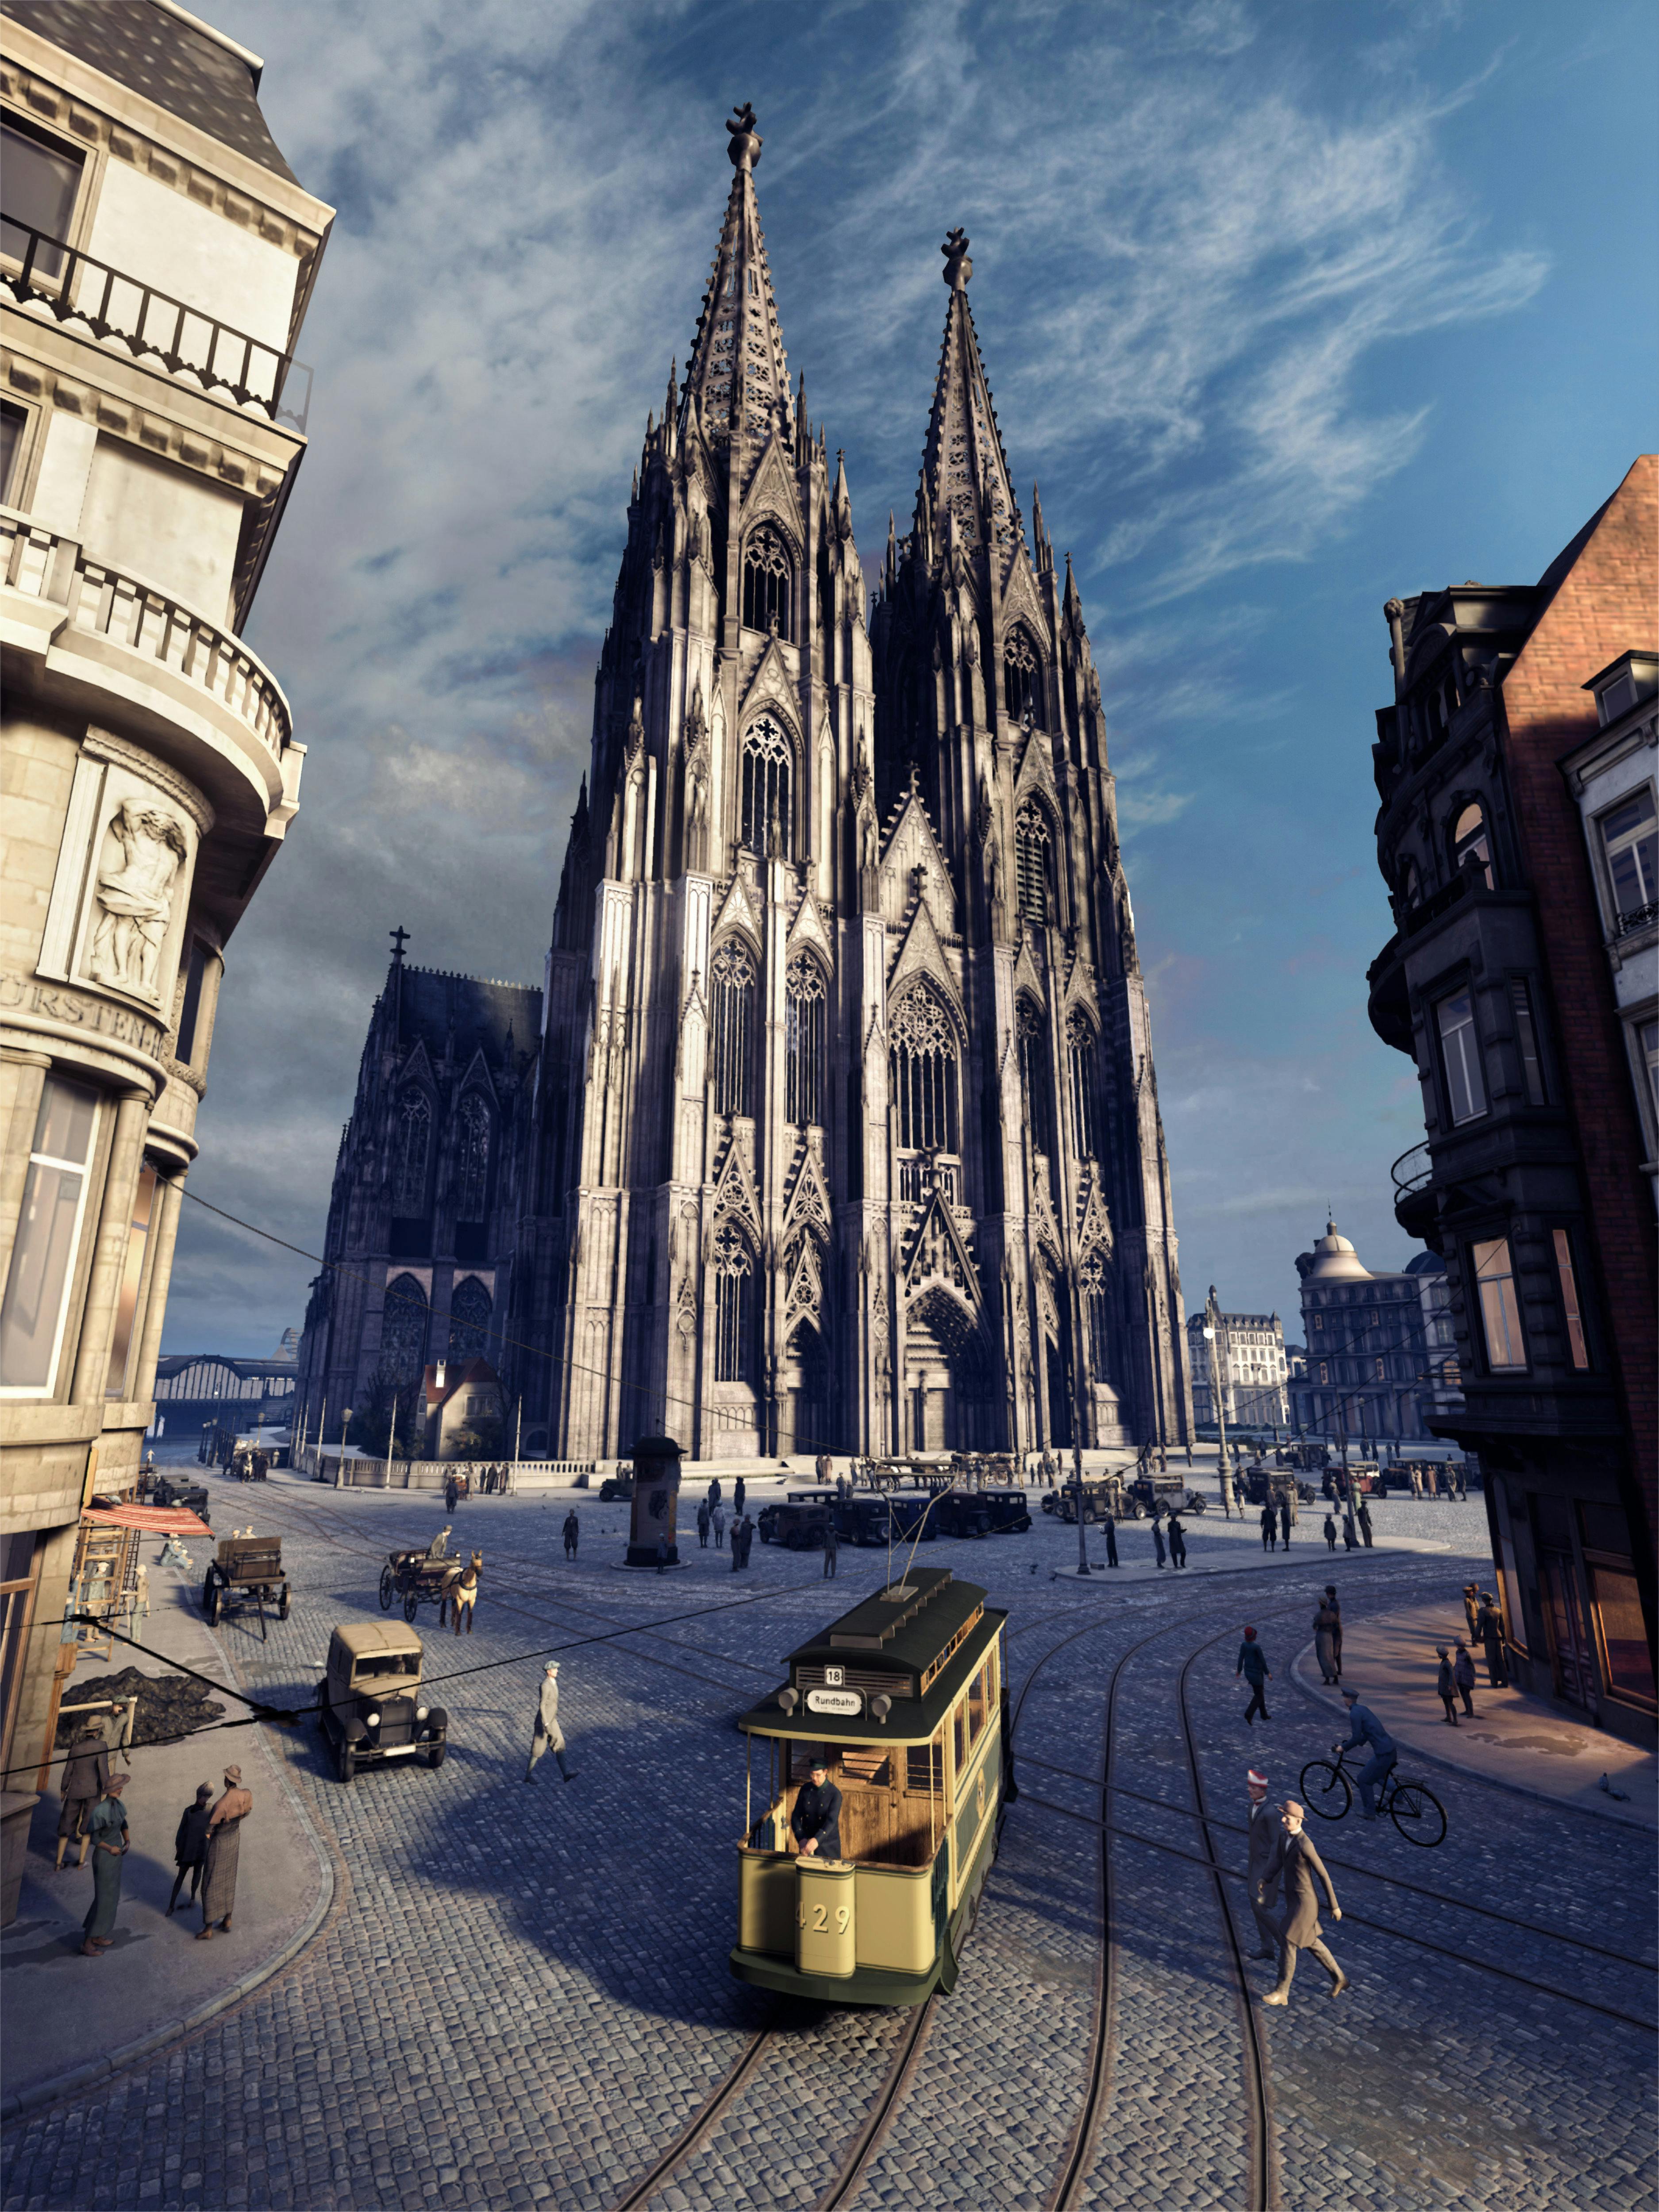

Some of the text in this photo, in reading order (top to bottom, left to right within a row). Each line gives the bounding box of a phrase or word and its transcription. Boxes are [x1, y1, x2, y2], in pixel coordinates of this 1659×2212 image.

[828, 1671, 840, 1682] 18
[815, 1696, 856, 1707] Rundbahn
[796, 1901, 850, 1935] 429
